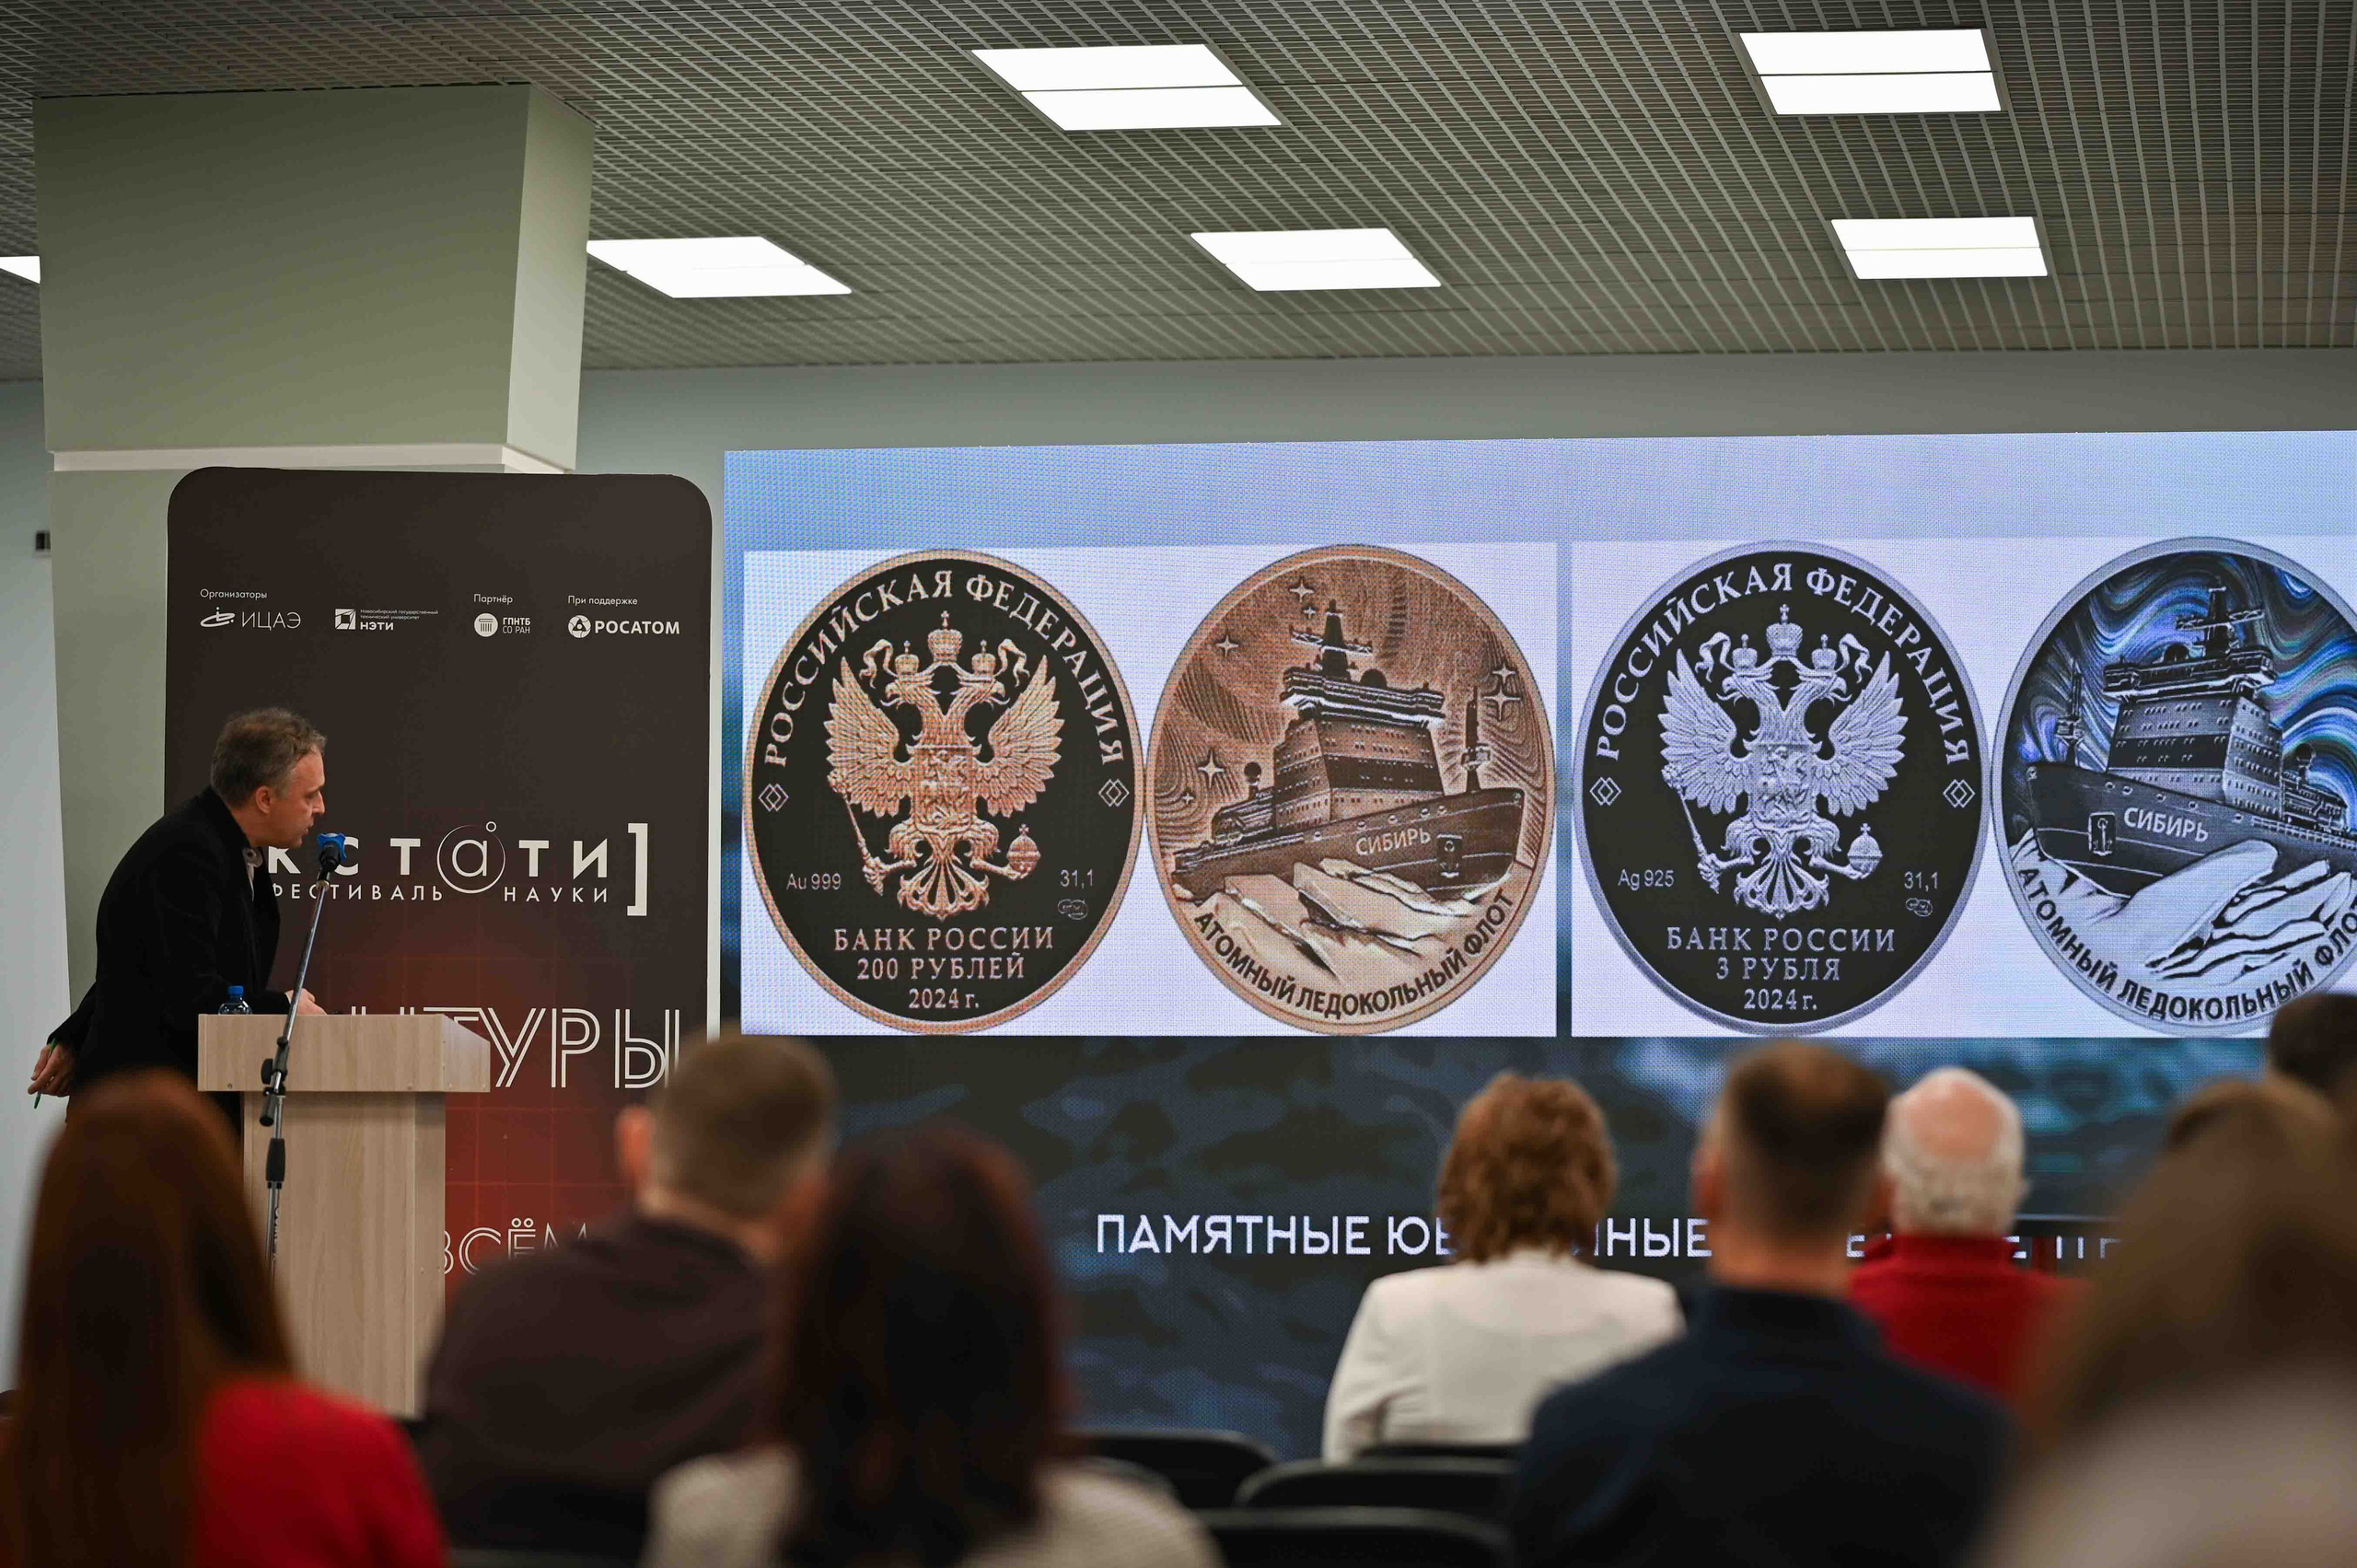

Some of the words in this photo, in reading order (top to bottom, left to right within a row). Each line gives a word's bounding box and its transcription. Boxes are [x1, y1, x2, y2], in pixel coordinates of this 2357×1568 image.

[200, 588, 267, 600] Организаторы
[473, 593, 513, 605] Партнёр
[567, 595, 586, 607] При
[588, 598, 638, 607] поддержке
[241, 611, 301, 631] ИЦАЭ
[360, 621, 394, 631] НЭТИ
[503, 617, 531, 626] ГПНТБ
[503, 625, 512, 634] СО
[515, 626, 530, 635] РАН
[595, 621, 680, 634] РОСАТОМ
[764, 570, 953, 767] РОССИЙСКАЯ
[966, 573, 1125, 765] ФЕДЕРАЦИЯ
[1596, 563, 1793, 761] РОССИЙСКАЯ
[1805, 567, 1970, 765] ФЕДЕРАЦИЯ
[2123, 807, 2209, 842] СИБИРЬ
[1355, 830, 1432, 856] СИБИРЬ
[786, 873, 807, 890] Au
[811, 873, 842, 890] 999
[1060, 870, 1094, 889] 31,1
[1618, 869, 1642, 891] Ag
[1643, 870, 1674, 888] 925
[1904, 871, 1938, 891] 31,1
[504, 887, 609, 903] НАУКИ
[834, 928, 916, 952] БАНК
[927, 926, 1054, 950] РОССИИ
[1666, 927, 1752, 951] БАНК
[1763, 928, 1896, 952] РОССИИ
[2019, 868, 2119, 992] АТОМНЫЙ
[2118, 958, 2315, 1021] ЛЕДОКОЛЬНЫЙ
[1194, 912, 1296, 1003] АТОМНЫЙ
[1295, 946, 1469, 1019] ЛЕДОКОЛЬНЫЙ
[1464, 887, 1515, 958] ФЛОТ
[857, 958, 899, 980] 200
[911, 951, 1025, 980] РУБЛЕЙ
[1716, 958, 1730, 980] 3
[1743, 958, 1840, 981] РУБЛЯ
[909, 988, 962, 1009] 2024
[965, 993, 980, 1009] г.
[1744, 989, 1797, 1010] 2024
[1802, 993, 1817, 1010] г.
[1097, 1214, 1370, 1255] ПАМЯТНЫЕ
